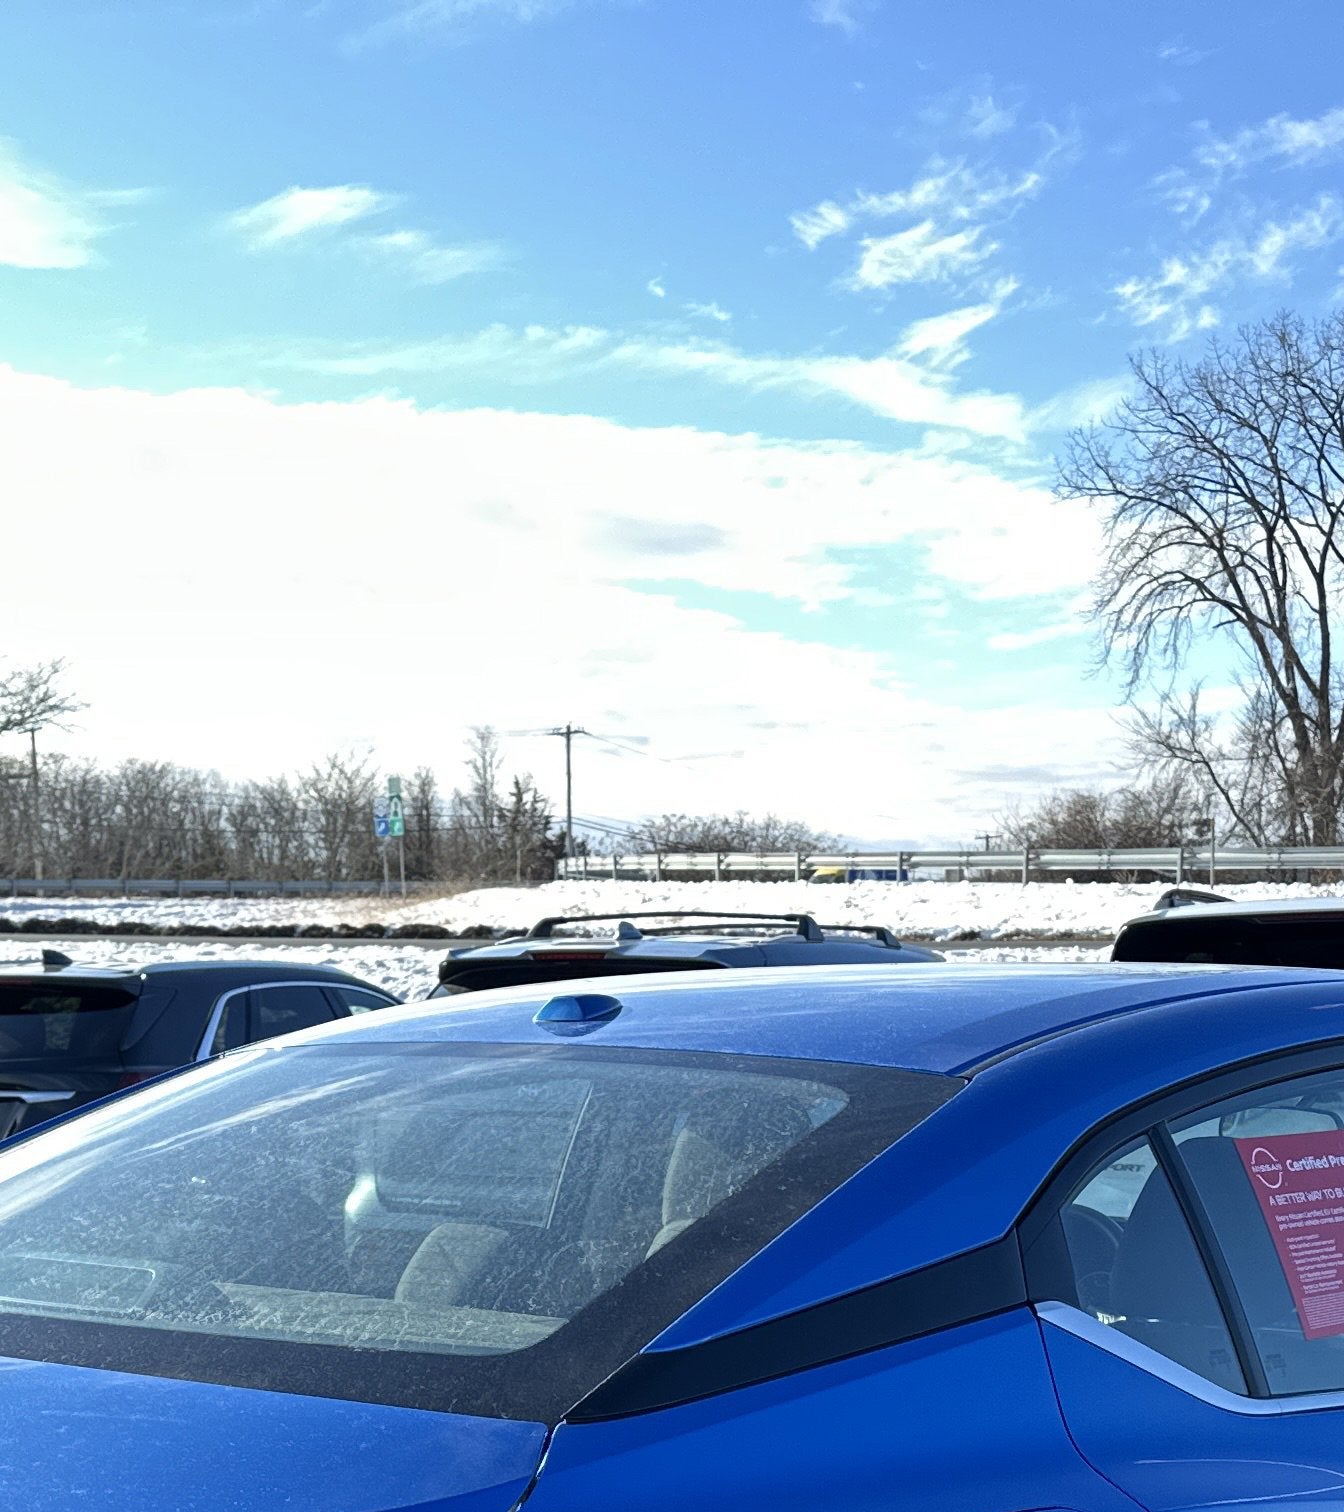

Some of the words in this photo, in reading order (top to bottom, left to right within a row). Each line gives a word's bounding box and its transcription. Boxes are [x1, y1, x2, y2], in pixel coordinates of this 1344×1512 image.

[1251, 1163, 1283, 1173] NISSAN
[1286, 1155, 1329, 1172] Certified
[1269, 1196, 1276, 1206] A
[1276, 1192, 1306, 1206] BETTER
[1306, 1190, 1323, 1202] WAY
[1323, 1188, 1335, 1200] TO
